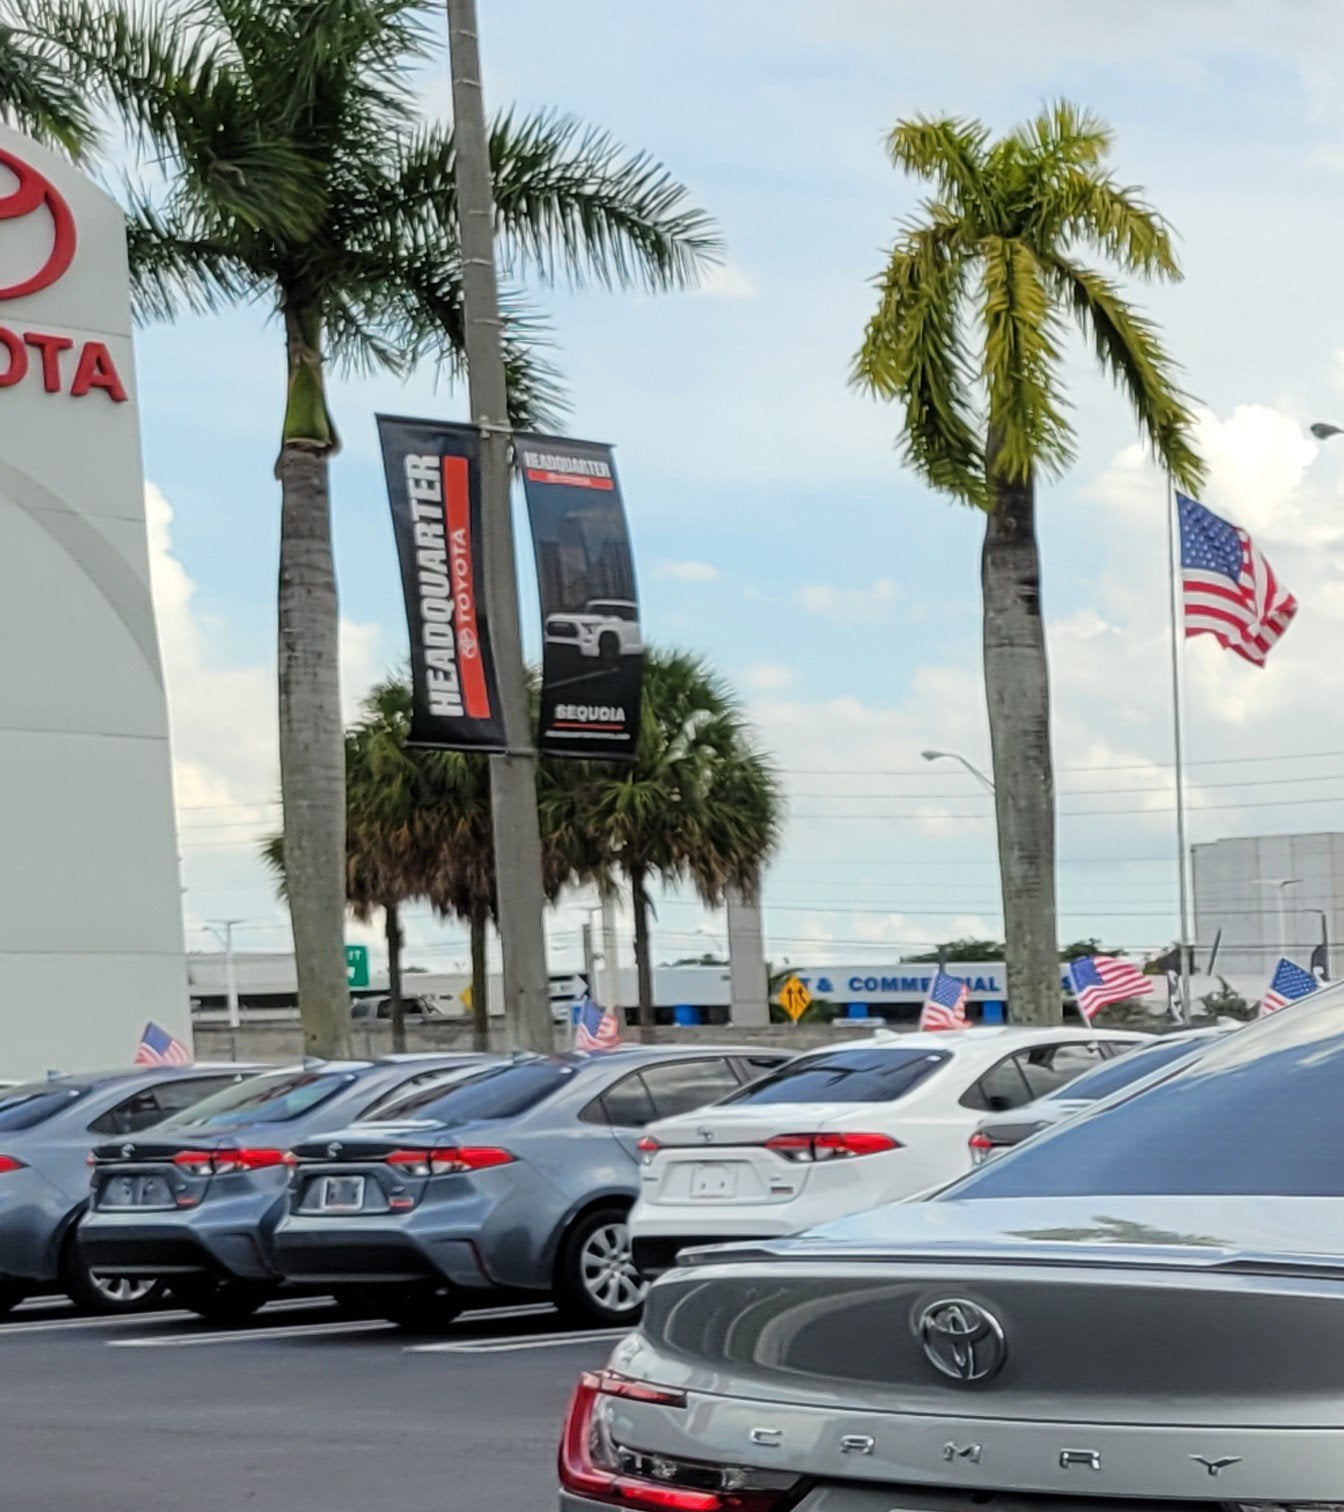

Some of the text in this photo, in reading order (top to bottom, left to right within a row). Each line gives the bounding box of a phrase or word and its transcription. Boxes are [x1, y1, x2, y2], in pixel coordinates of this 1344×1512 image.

[403, 452, 464, 717] HEADQUARTER
[451, 528, 472, 623] TOYOTA
[554, 703, 626, 722] SEQUOIA
[847, 976, 1001, 992] COMMEIAL
[749, 1427, 1243, 1476] CAMRY
